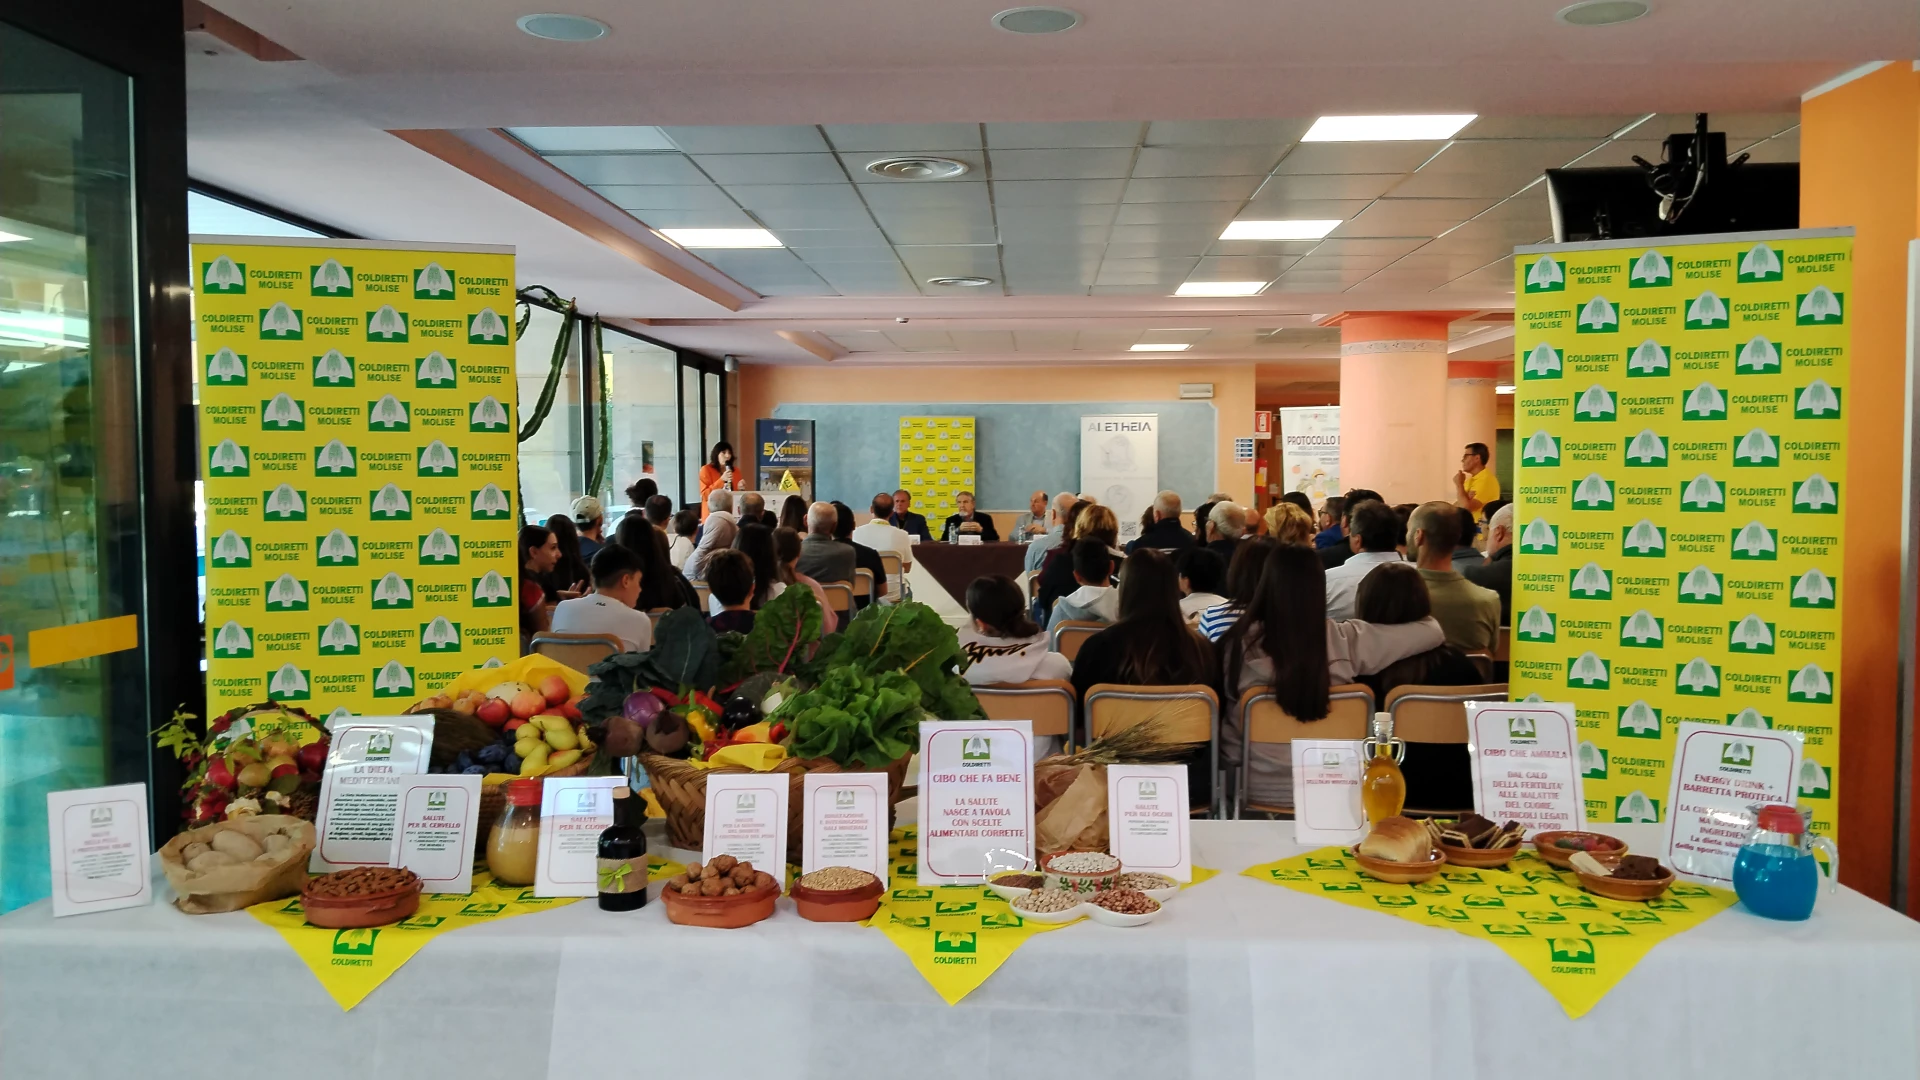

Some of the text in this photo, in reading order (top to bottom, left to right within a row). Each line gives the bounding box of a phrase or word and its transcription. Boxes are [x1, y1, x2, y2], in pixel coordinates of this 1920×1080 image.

[1788, 253, 1845, 264] COLDIRETTI
[1569, 265, 1621, 275] COLDIRETTI
[1797, 263, 1835, 273] MOLISE
[250, 270, 302, 280] COLDIRETTI
[1577, 274, 1612, 284] MOLISE
[258, 280, 294, 290] MOLISE
[459, 276, 508, 287] COLDIRETTI
[467, 286, 500, 296] MOLISE
[1623, 306, 1676, 317] COLDIRETTI
[307, 317, 358, 326] COLDIRETTI
[1632, 316, 1667, 326] MOLISE
[315, 326, 350, 336] MOLISE
[1786, 347, 1843, 358] COLDIRETTI
[1567, 354, 1619, 363] COLDIRETTI
[1795, 357, 1833, 367] MOLISE
[252, 361, 304, 371] COLDIRETTI
[461, 365, 509, 375] COLDIRETTI
[1575, 363, 1610, 372] MOLISE
[260, 370, 296, 380] MOLISE
[469, 374, 501, 383] MOLISE
[1621, 396, 1674, 406] COLDIRETTI
[309, 407, 360, 416] COLDIRETTI
[1630, 406, 1664, 415] MOLISE
[318, 416, 351, 426] MOLISE
[1088, 422, 1151, 431] ALETHEIA
[1287, 436, 1336, 445] PROTOCOLLO
[1565, 443, 1616, 452] COLDIRETTI
[1784, 441, 1840, 452] COLDIRETTI
[254, 453, 306, 462] COLDIRETTI
[462, 454, 510, 462] COLDIRETTI
[1573, 452, 1607, 461] MOLISE
[1793, 451, 1831, 461] MOLISE
[262, 462, 297, 471] MOLISE
[470, 462, 503, 471] MOLISE
[1619, 487, 1672, 497] COLDIRETTI
[311, 496, 362, 506] COLDIRETTI
[1627, 497, 1662, 505] MOLISE
[319, 506, 353, 515] MOLISE
[1562, 531, 1614, 541] COLDIRETTI
[1782, 535, 1838, 546] COLDIRETTI
[256, 542, 308, 552] COLDIRETTI
[464, 540, 512, 550] COLDIRETTI
[1571, 541, 1605, 550] MOLISE
[1791, 545, 1829, 555] MOLISE
[264, 552, 299, 561] MOLISE
[472, 549, 504, 558] MOLISE
[1617, 576, 1669, 587] COLDIRETTI
[313, 586, 363, 595] COLDIRETTI
[1625, 586, 1660, 596] MOLISE
[321, 595, 355, 604] MOLISE
[1560, 619, 1612, 630] COLDIRETTI
[258, 632, 310, 642] COLDIRETTI
[465, 627, 513, 637] COLDIRETTI
[1568, 629, 1603, 639] MOLISE
[1780, 629, 1835, 641] COLDIRETTI
[266, 641, 301, 651] MOLISE
[473, 636, 505, 646] MOLISE
[1789, 640, 1826, 650] MOLISE
[1614, 666, 1667, 678] COLDIRETTI
[314, 675, 365, 684] COLDIRETTI
[1623, 676, 1658, 687] MOLISE
[323, 684, 356, 693] MOLISE
[1576, 710, 1609, 719] DIRETTI
[1576, 720, 1600, 728] OLISE
[1531, 750, 1567, 758] AMMALA
[1612, 757, 1665, 768] COLDIRETTI
[1620, 767, 1655, 777] MOLISE
[340, 776, 400, 785] MEDITERRAN
[933, 774, 1021, 782] CIBO CHE FA BENE
[1695, 774, 1731, 786] ENERGY
[1734, 780, 1765, 789] DRINK
[1683, 784, 1782, 802] BARRETTA PROTEICA
[1680, 804, 1690, 812] LA
[1499, 811, 1537, 819] PERICOLI
[1700, 827, 1746, 839] INGREDIEN
[331, 958, 372, 967] COLDIRETTI
[934, 956, 977, 965] COLDIRETTI
[1551, 965, 1596, 975] COLDIRETTI
